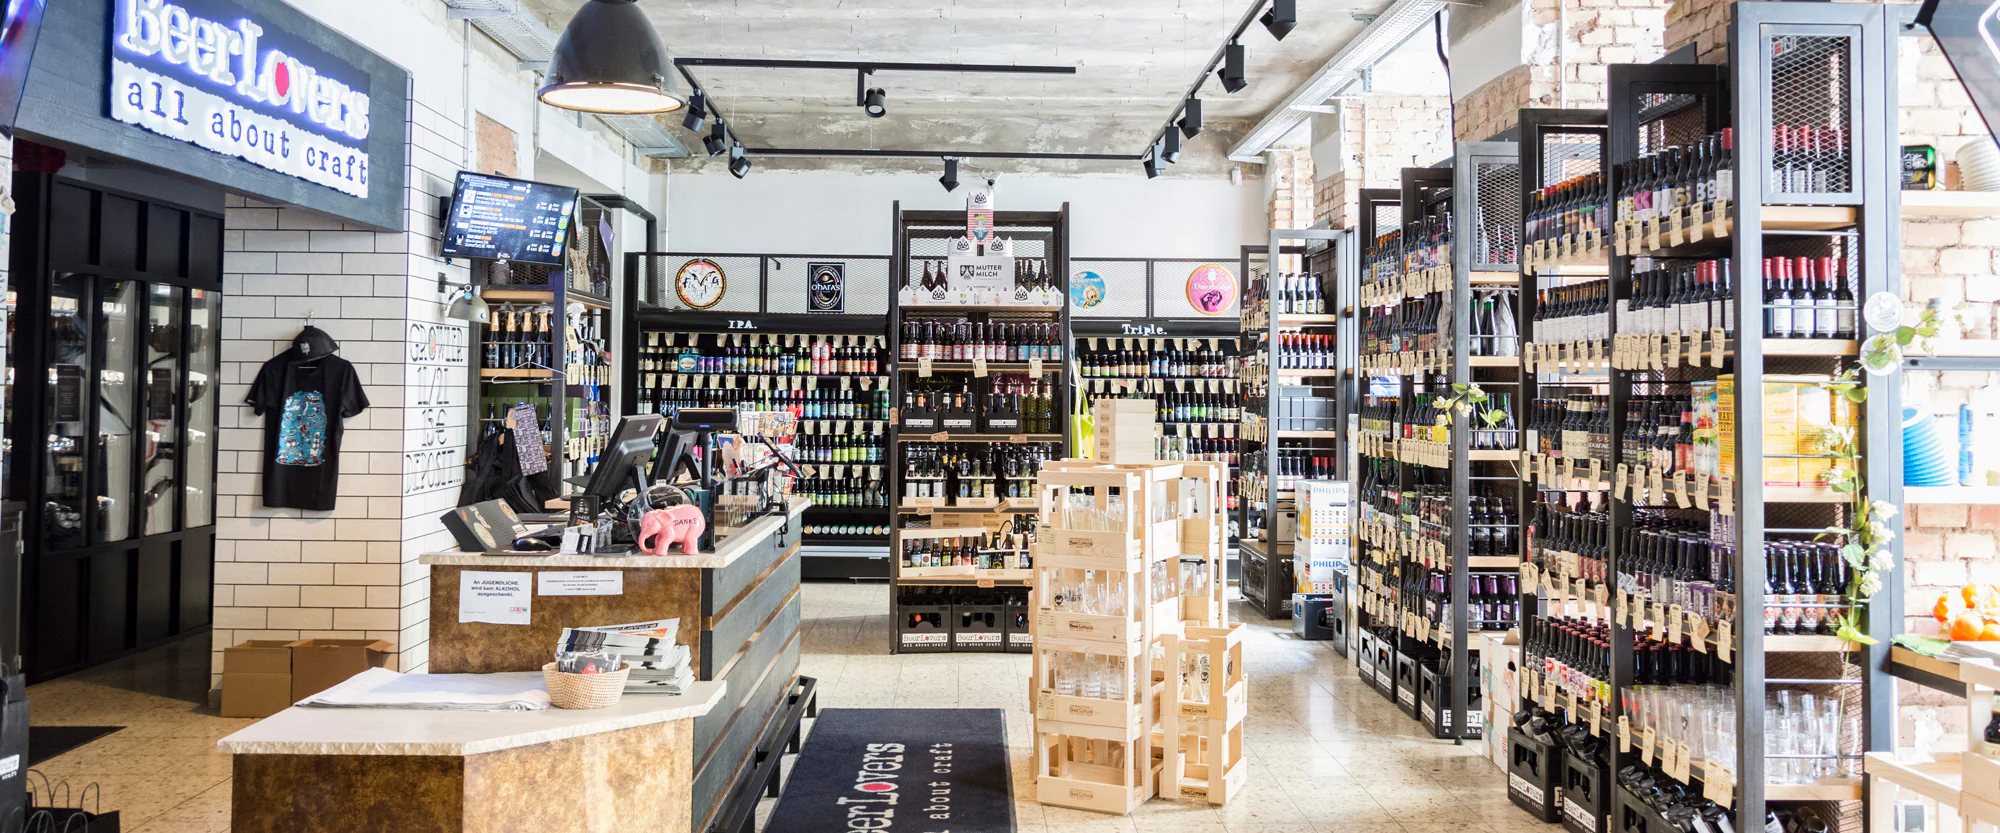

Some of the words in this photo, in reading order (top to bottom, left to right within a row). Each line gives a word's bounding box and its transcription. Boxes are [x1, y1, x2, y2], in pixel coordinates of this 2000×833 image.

[120, 0, 370, 140] BeerLovers
[127, 81, 189, 126] all
[211, 108, 290, 159] about
[305, 145, 368, 186] craft
[728, 320, 757, 329] IPA.
[1121, 323, 1168, 336] Triple.
[405, 449, 462, 493] DEPOSIT
[673, 518, 698, 527] DANKE
[929, 742, 953, 774] craft
[922, 780, 951, 820] about
